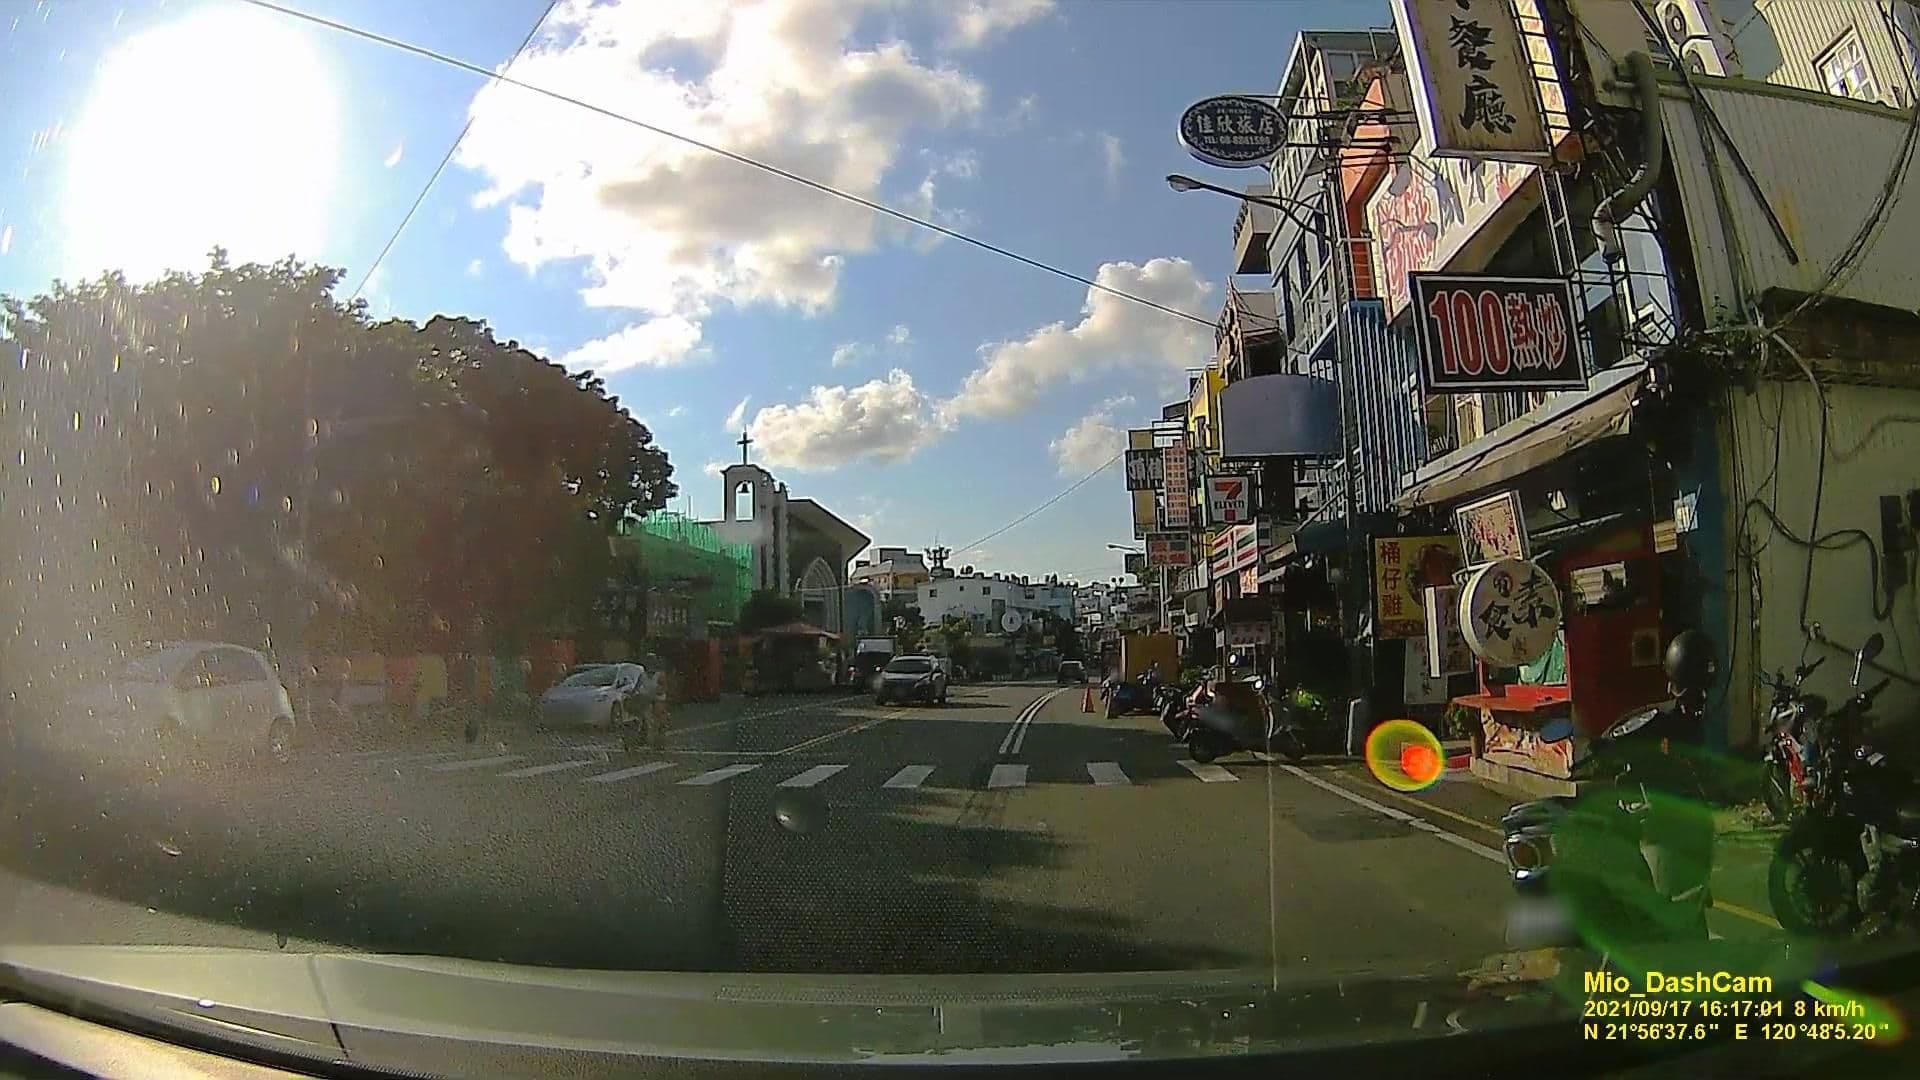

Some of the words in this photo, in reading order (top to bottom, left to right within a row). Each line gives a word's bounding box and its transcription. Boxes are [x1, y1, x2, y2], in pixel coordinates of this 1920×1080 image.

[1449, 0, 1517, 134] 餐廳
[1380, 541, 1402, 617] 桶仔雞
